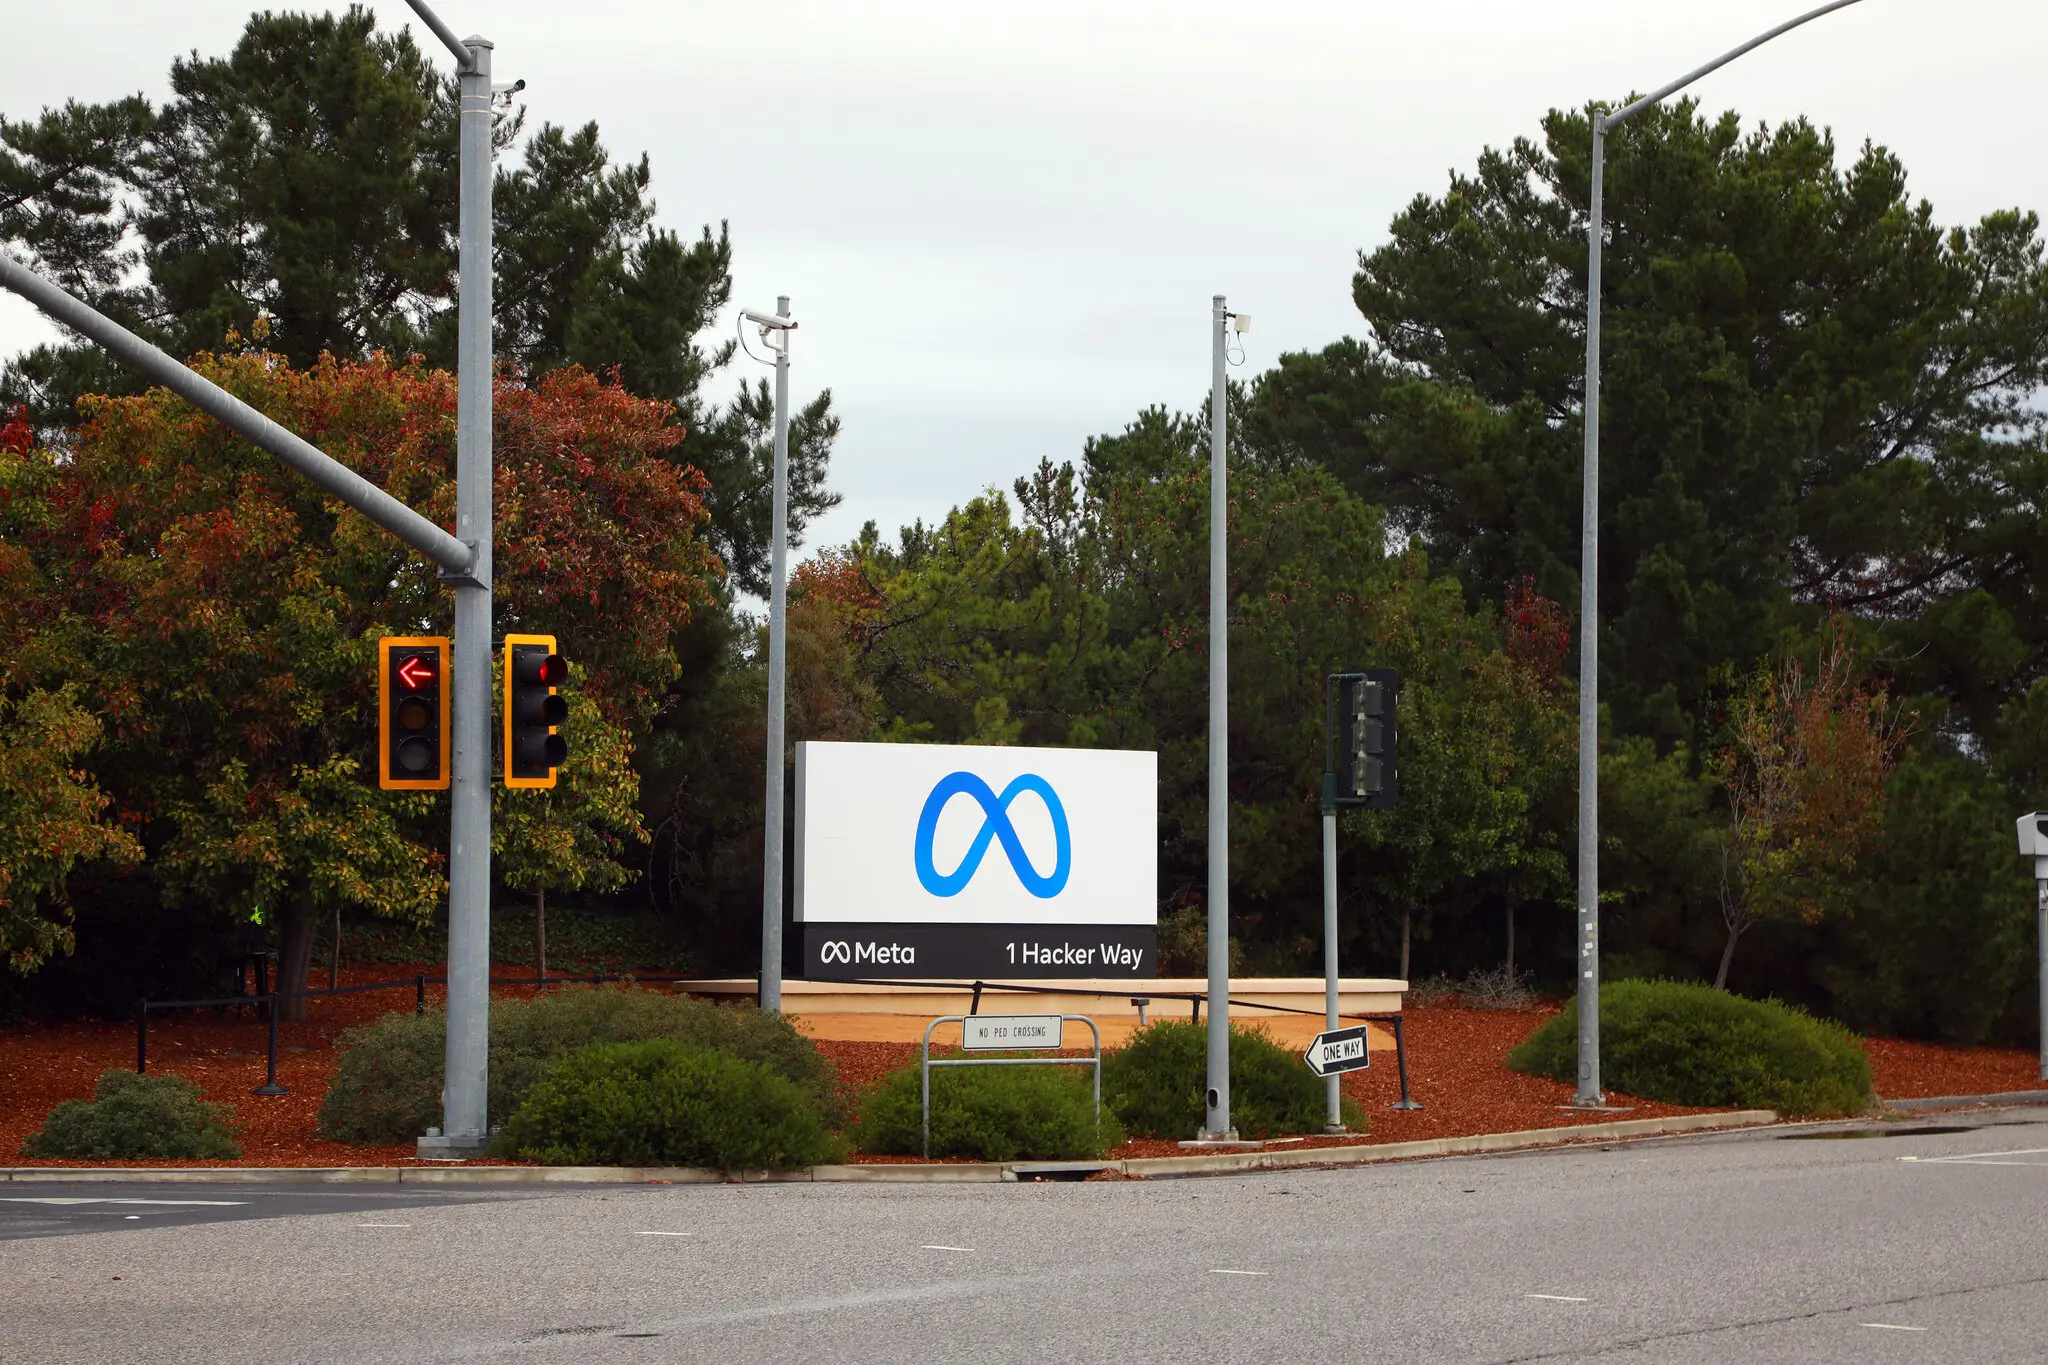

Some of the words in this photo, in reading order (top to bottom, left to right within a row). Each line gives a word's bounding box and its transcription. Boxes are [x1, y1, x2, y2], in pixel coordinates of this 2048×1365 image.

[855, 941, 915, 964] Meta
[1006, 942, 1015, 964] 1
[1022, 942, 1096, 965] Hacker
[1100, 943, 1143, 970] Way
[979, 1028, 988, 1038] NO
[994, 1027, 1008, 1037] PED
[1013, 1026, 1046, 1037] CROSSING
[1323, 1044, 1341, 1061] ONE
[1343, 1040, 1360, 1057] WAY
